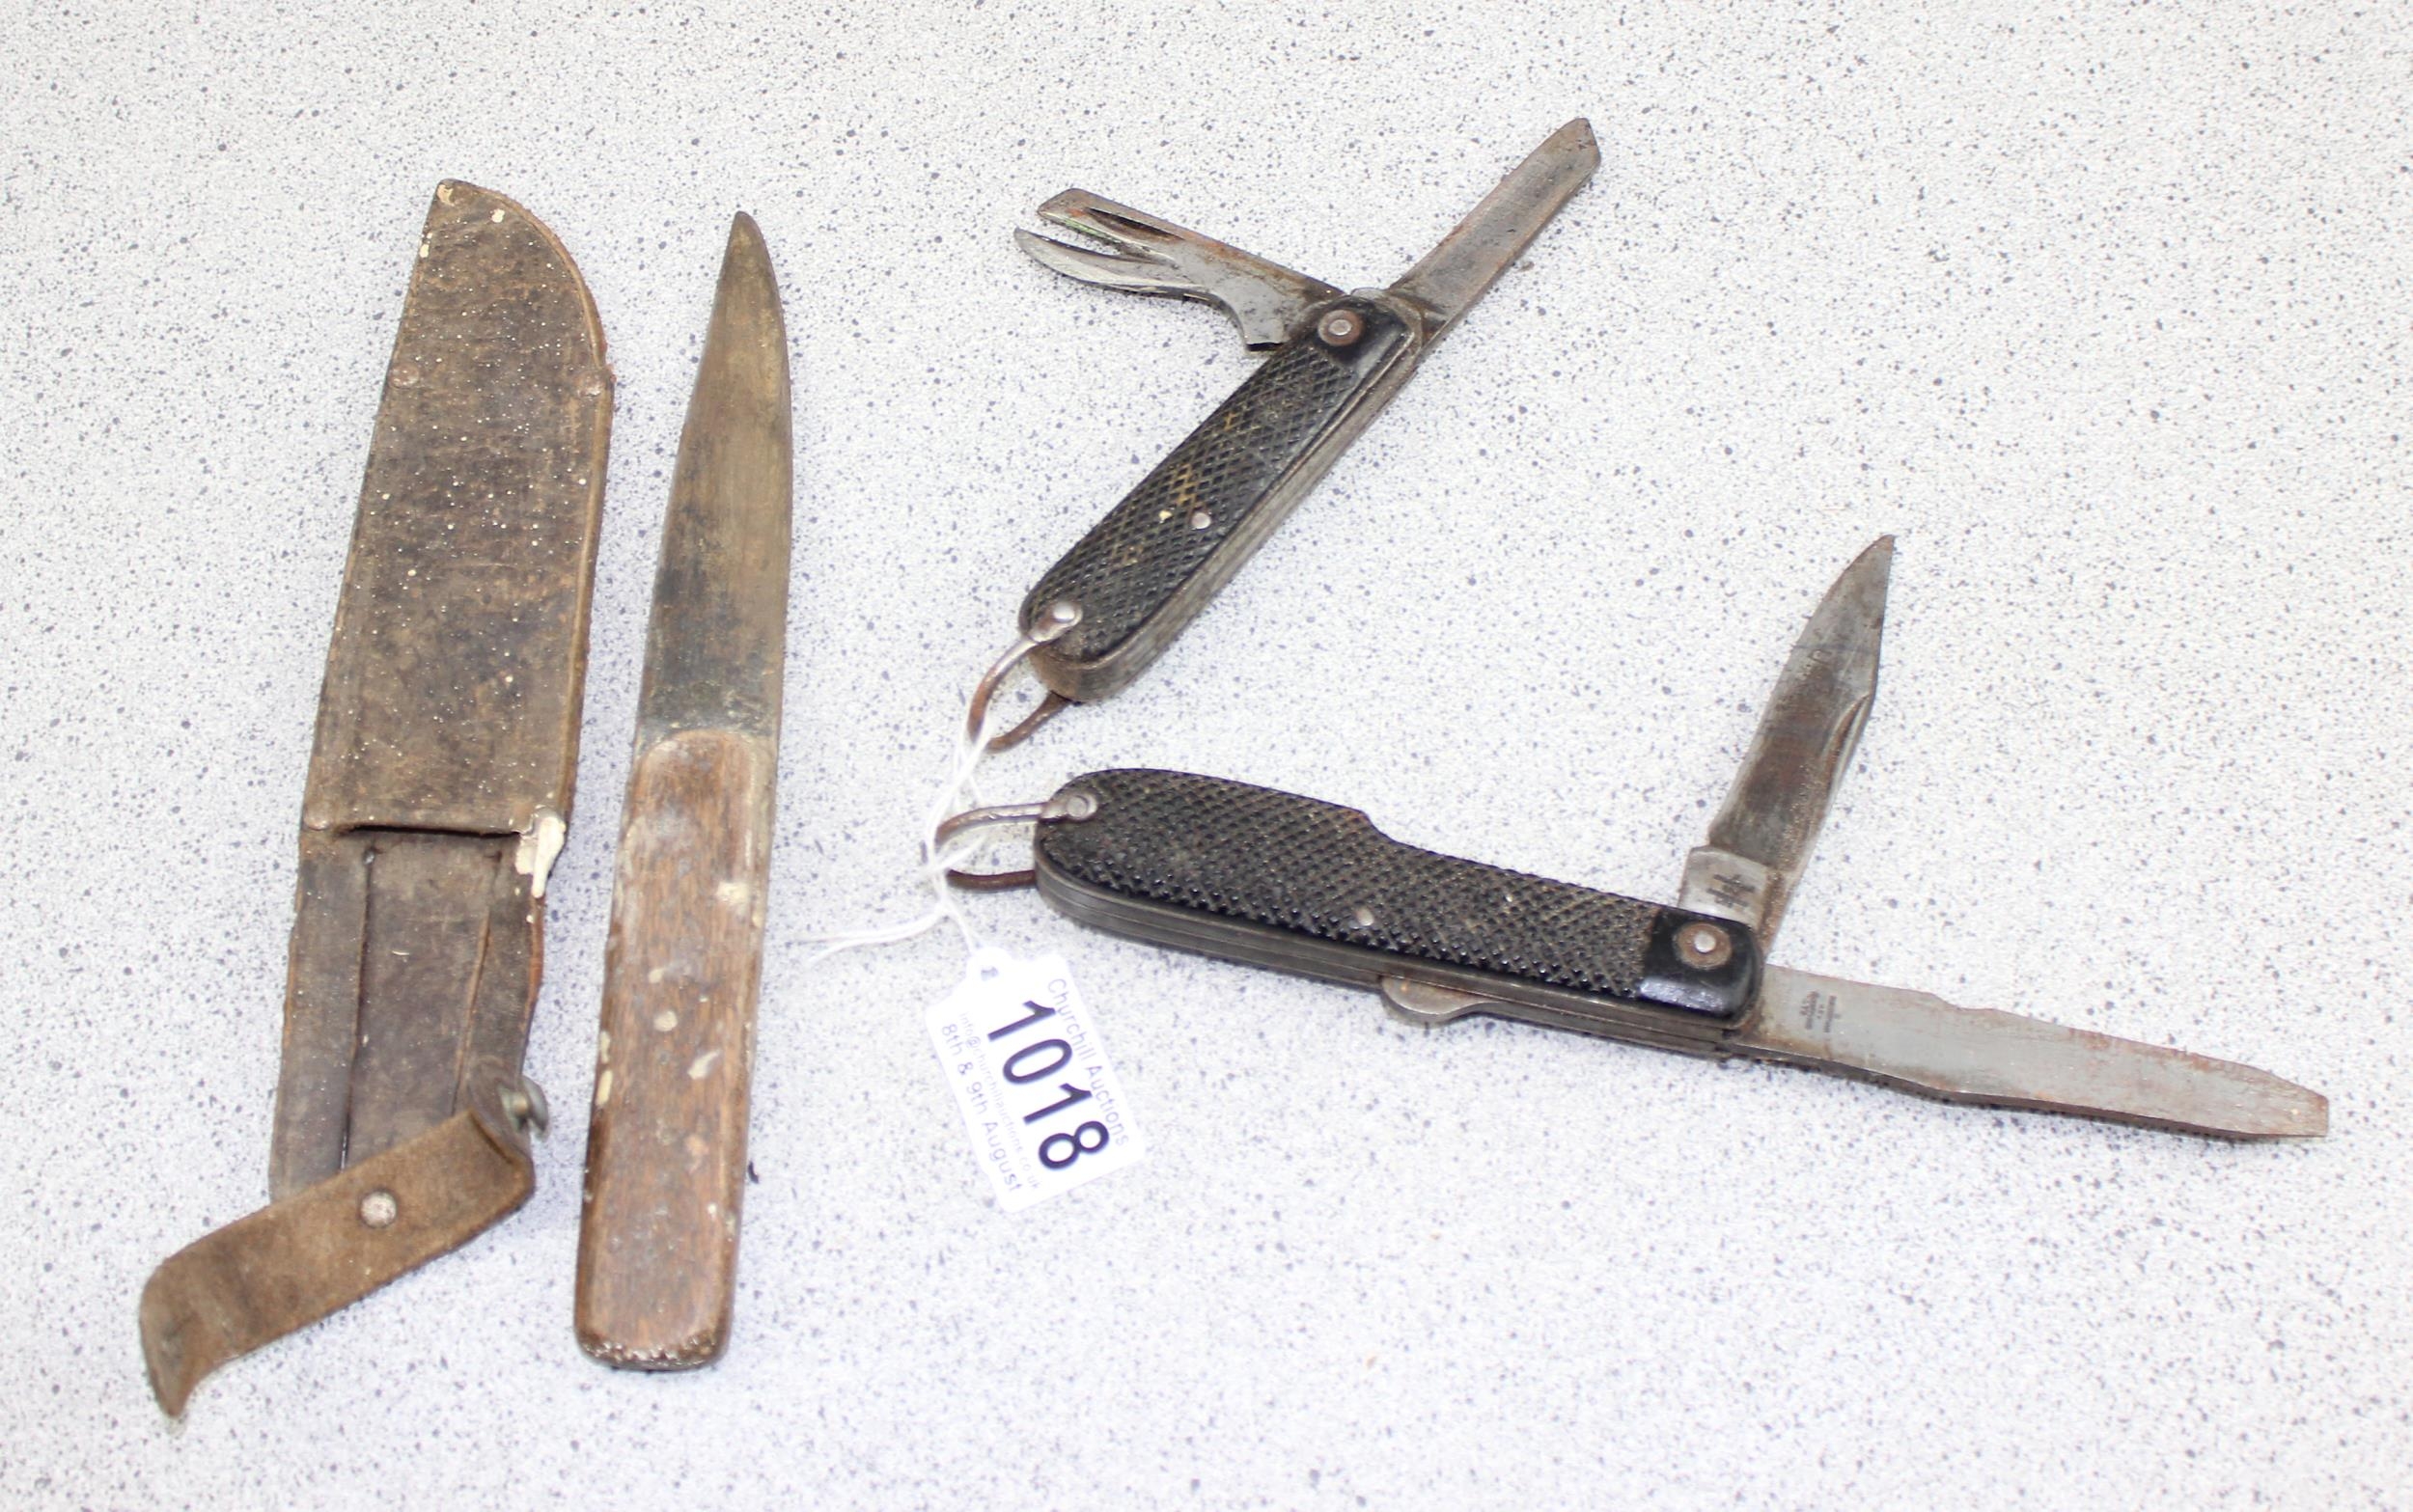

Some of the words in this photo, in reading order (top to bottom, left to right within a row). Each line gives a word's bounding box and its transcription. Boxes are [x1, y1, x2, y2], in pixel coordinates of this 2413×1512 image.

[941, 1023, 963, 1057] 8th
[957, 1061, 974, 1076] &
[966, 1081, 988, 1114] 9th
[982, 1120, 1023, 1193] August
[959, 1011, 1041, 1190] info@churchillauctionscouk
[986, 1000, 1110, 1171] 1018
[1047, 978, 1097, 1060] Churchill
[1085, 1064, 1129, 1146] Auctions
